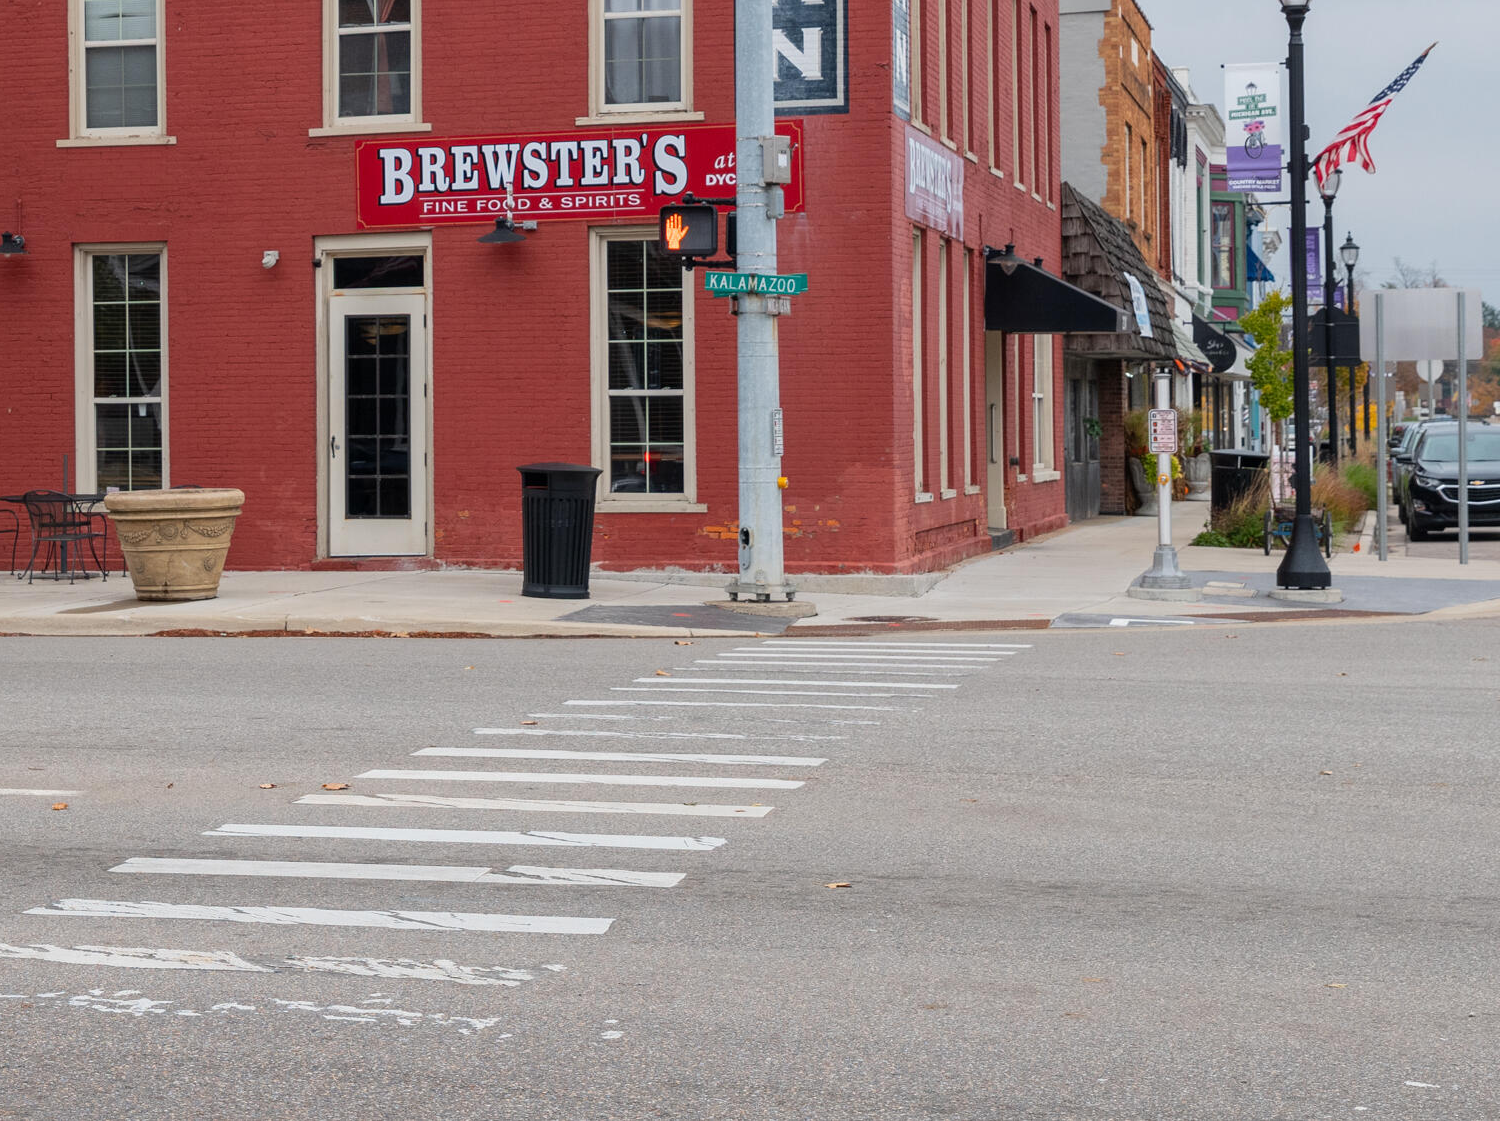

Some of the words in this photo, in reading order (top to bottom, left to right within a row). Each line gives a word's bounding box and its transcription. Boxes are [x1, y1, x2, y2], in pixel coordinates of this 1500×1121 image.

[378, 131, 688, 205] BREWSTER'S
[705, 172, 737, 187] DYC
[423, 200, 468, 213] FINE
[476, 198, 531, 211] FOOD
[539, 197, 553, 209] &
[560, 193, 641, 208] SPIRITS
[709, 274, 796, 293] KALAMAZOO
